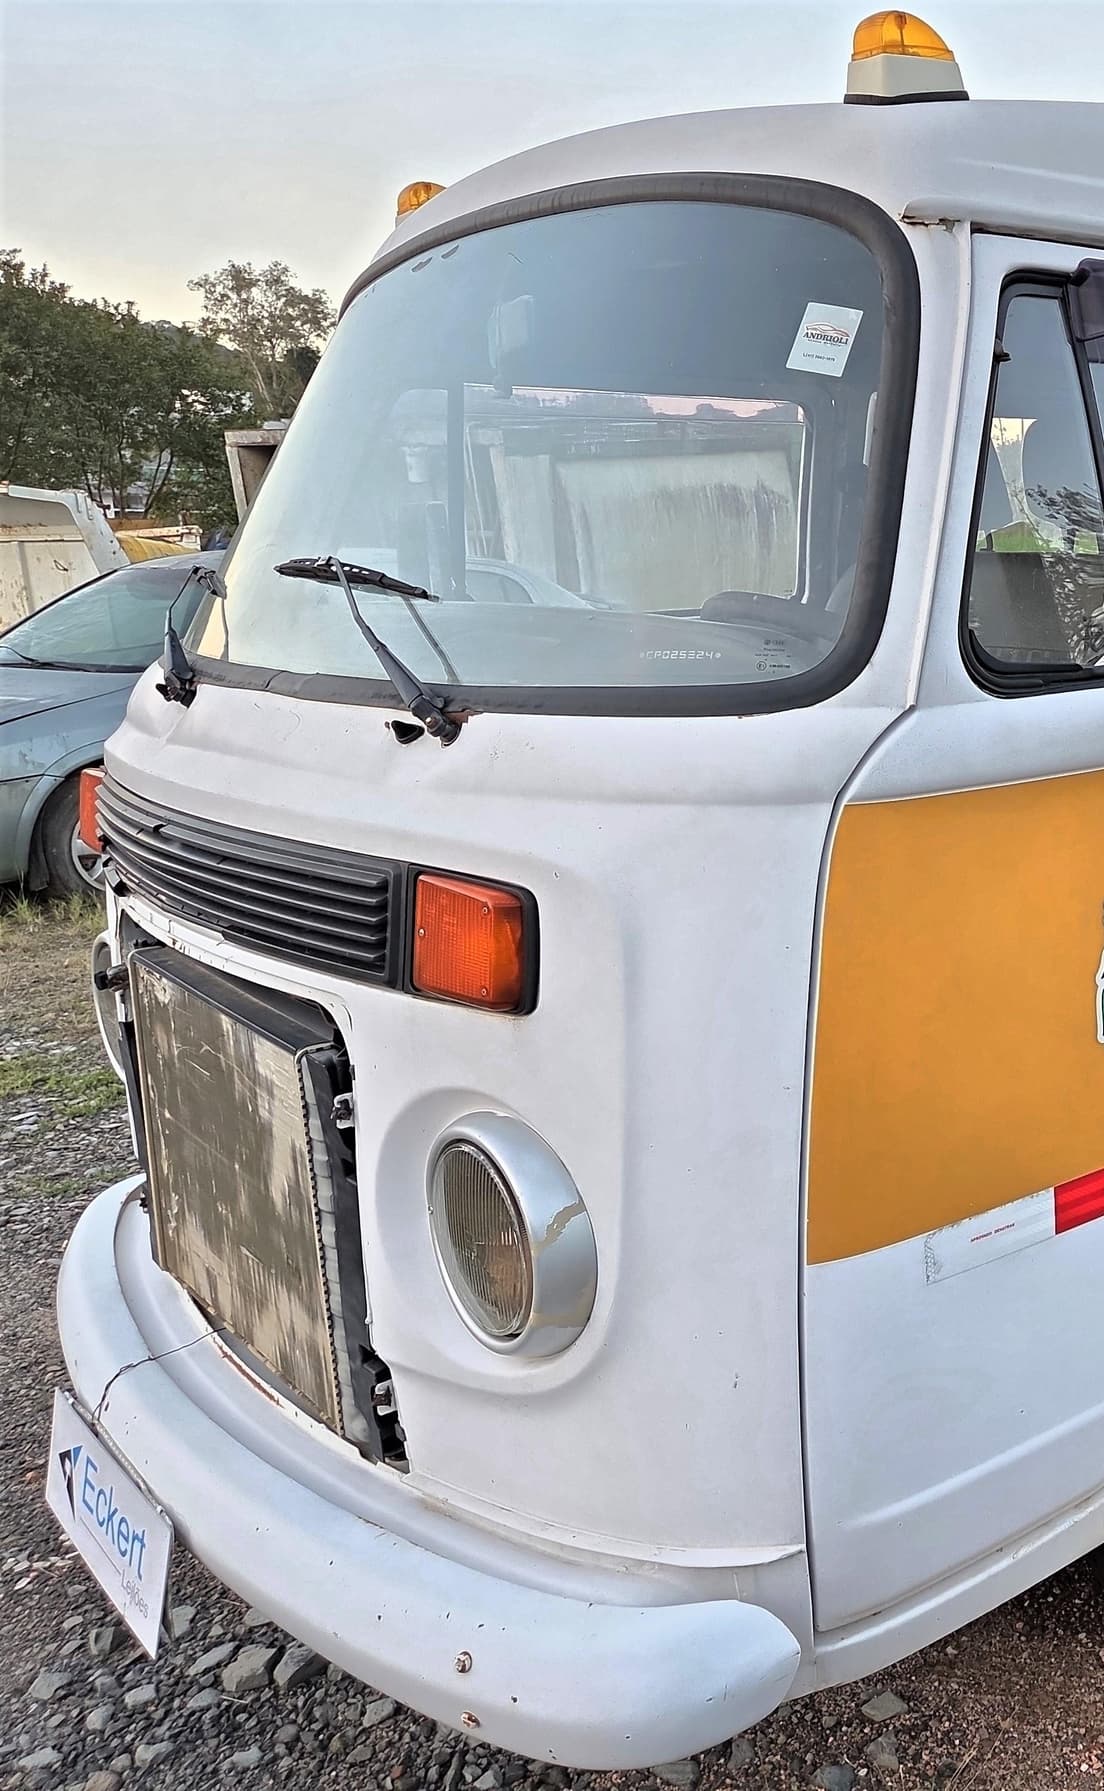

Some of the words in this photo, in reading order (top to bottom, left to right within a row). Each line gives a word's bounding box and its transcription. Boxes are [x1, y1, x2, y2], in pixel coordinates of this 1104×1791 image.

[803, 332, 849, 345] ANDRIOLI
[81, 1454, 147, 1582] Eckert
[120, 1568, 149, 1619] Leilões
